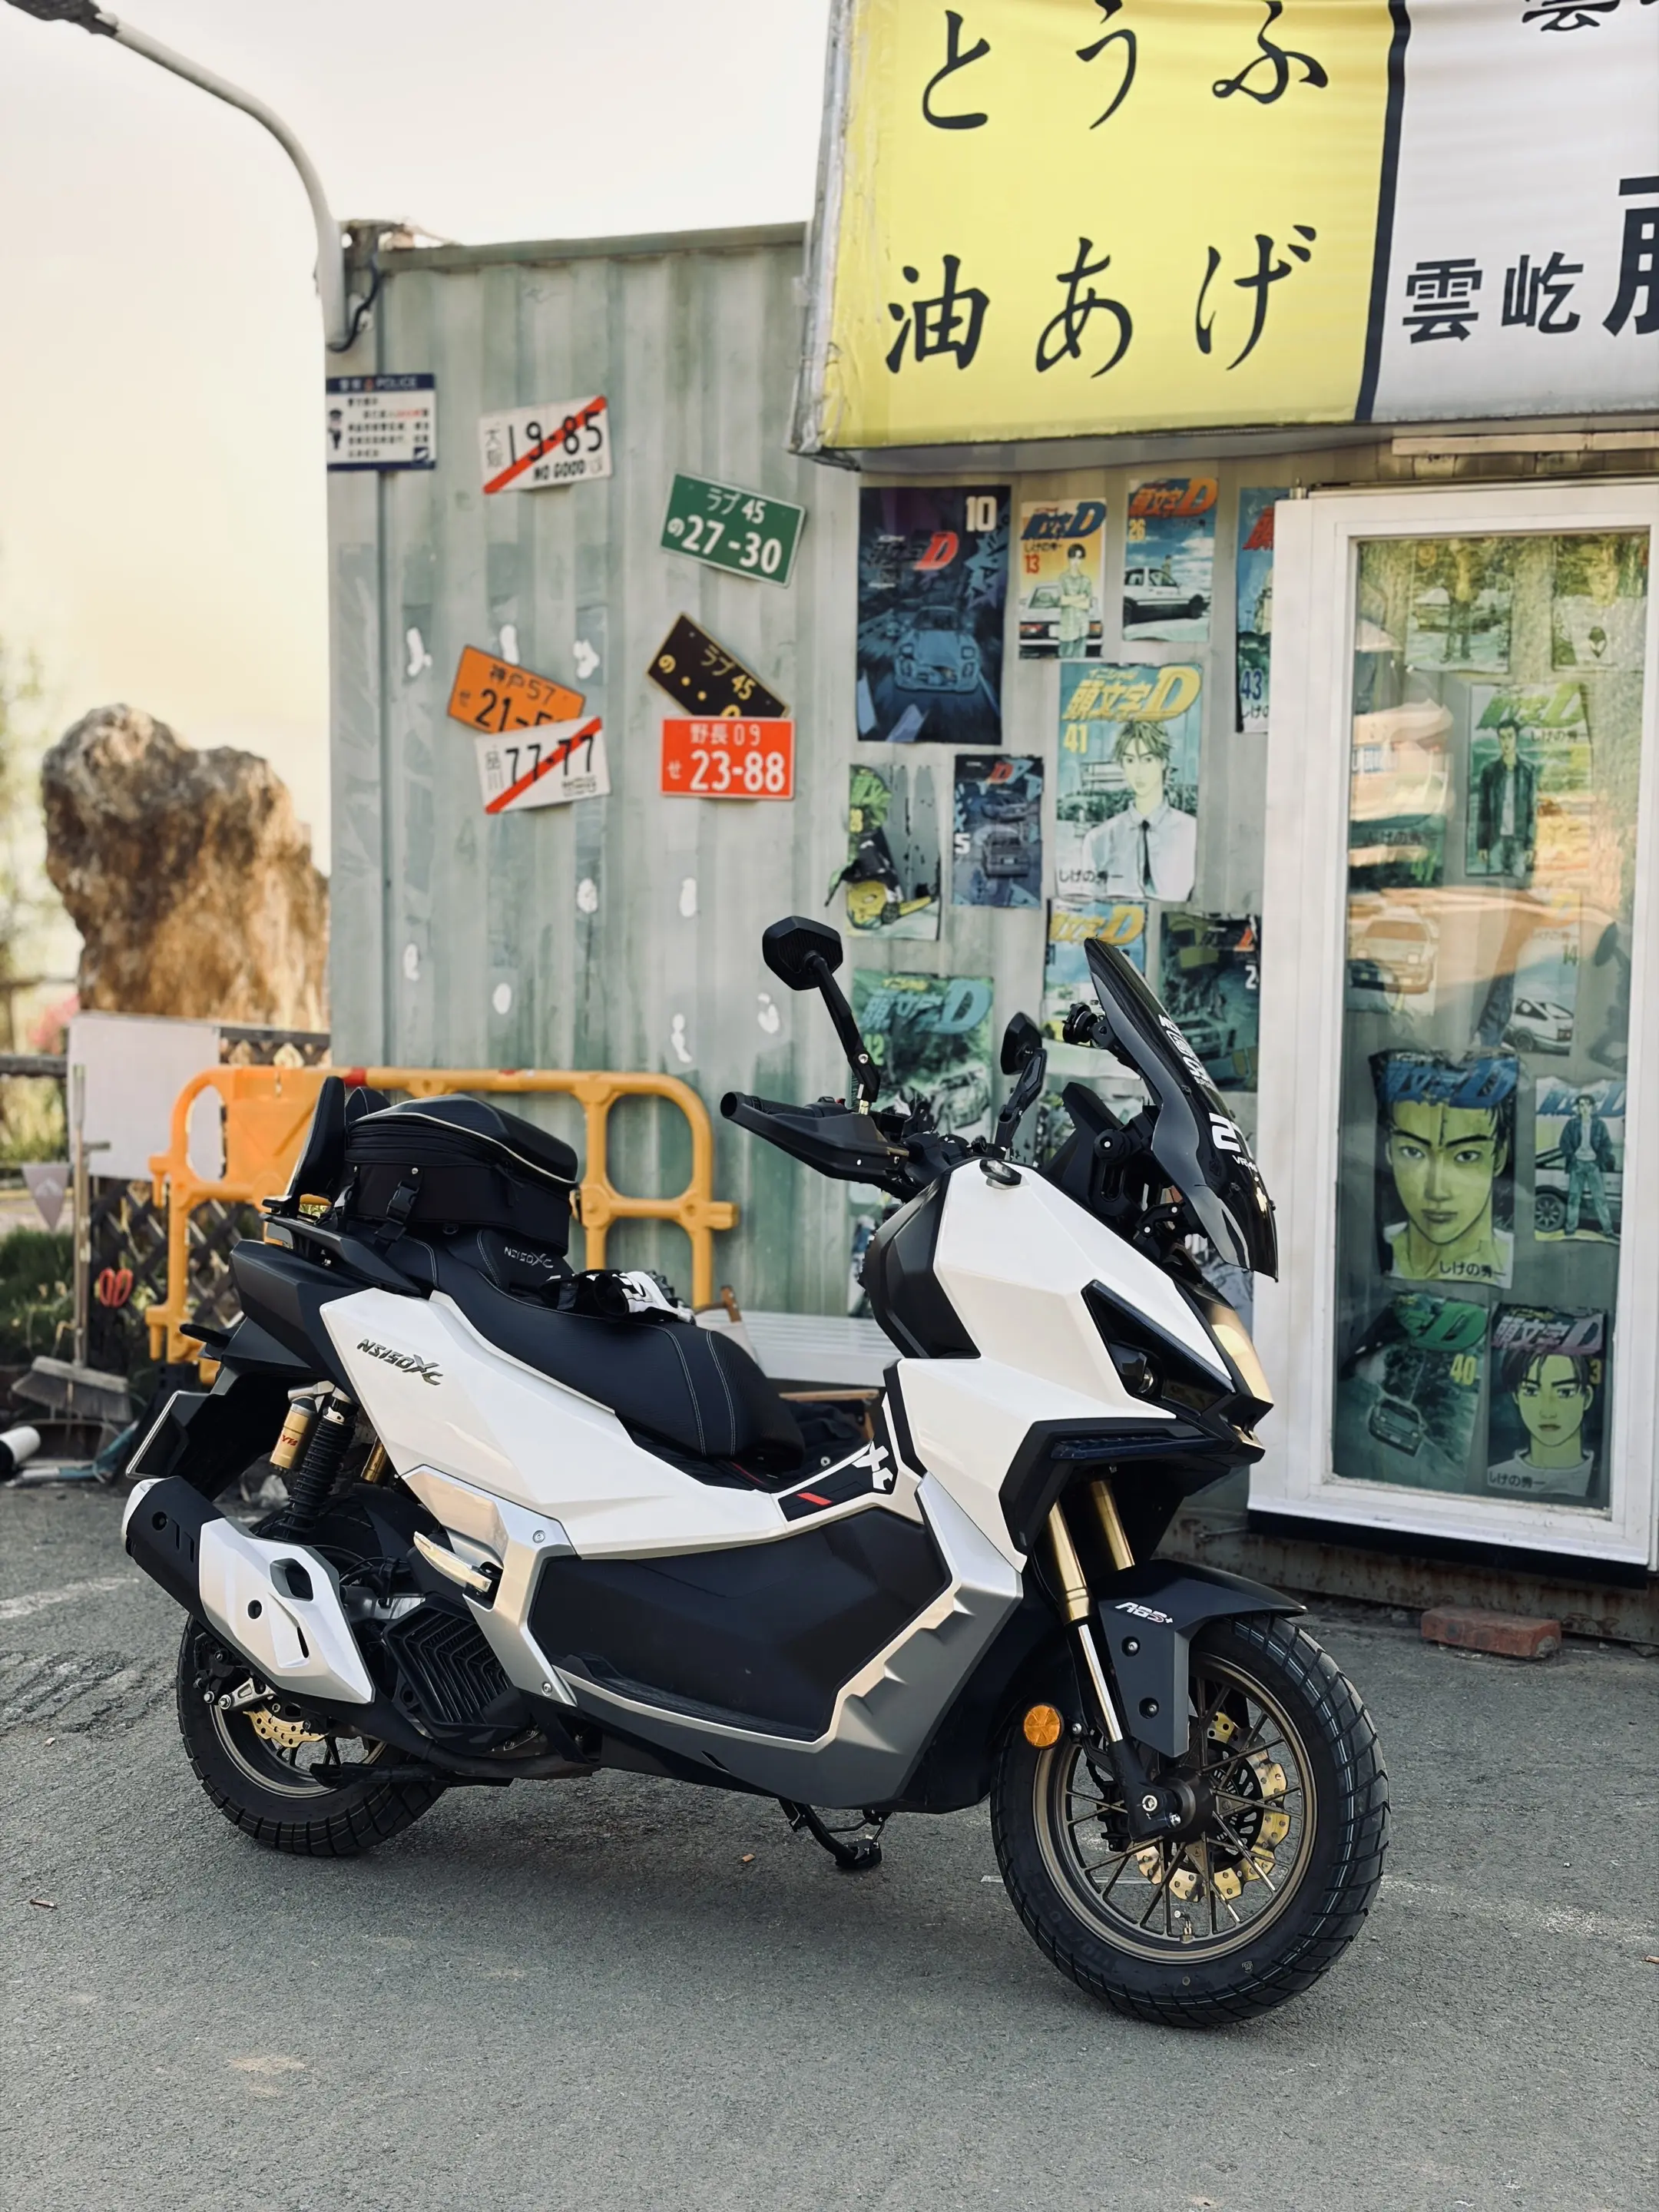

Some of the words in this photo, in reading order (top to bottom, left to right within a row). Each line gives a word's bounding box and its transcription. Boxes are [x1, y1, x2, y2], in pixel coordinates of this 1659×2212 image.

[922, 0, 1329, 130] とうふ
[885, 224, 1317, 379] 油あげ
[508, 411, 602, 465] 19-85
[966, 496, 997, 531] 10
[680, 515, 782, 574] 27-30
[1025, 554, 1041, 575] 13
[1241, 667, 1262, 700] 43
[1064, 724, 1088, 754] 41
[505, 734, 594, 785] 77-77
[667, 760, 682, 780] せ
[689, 749, 785, 793] 23-88
[954, 833, 971, 854] 5
[1439, 1261, 1506, 1279] しげの秀一
[356, 1339, 444, 1386] NS150XC
[1450, 1353, 1478, 1386] 40
[1488, 1470, 1546, 1488] しげの秀一
